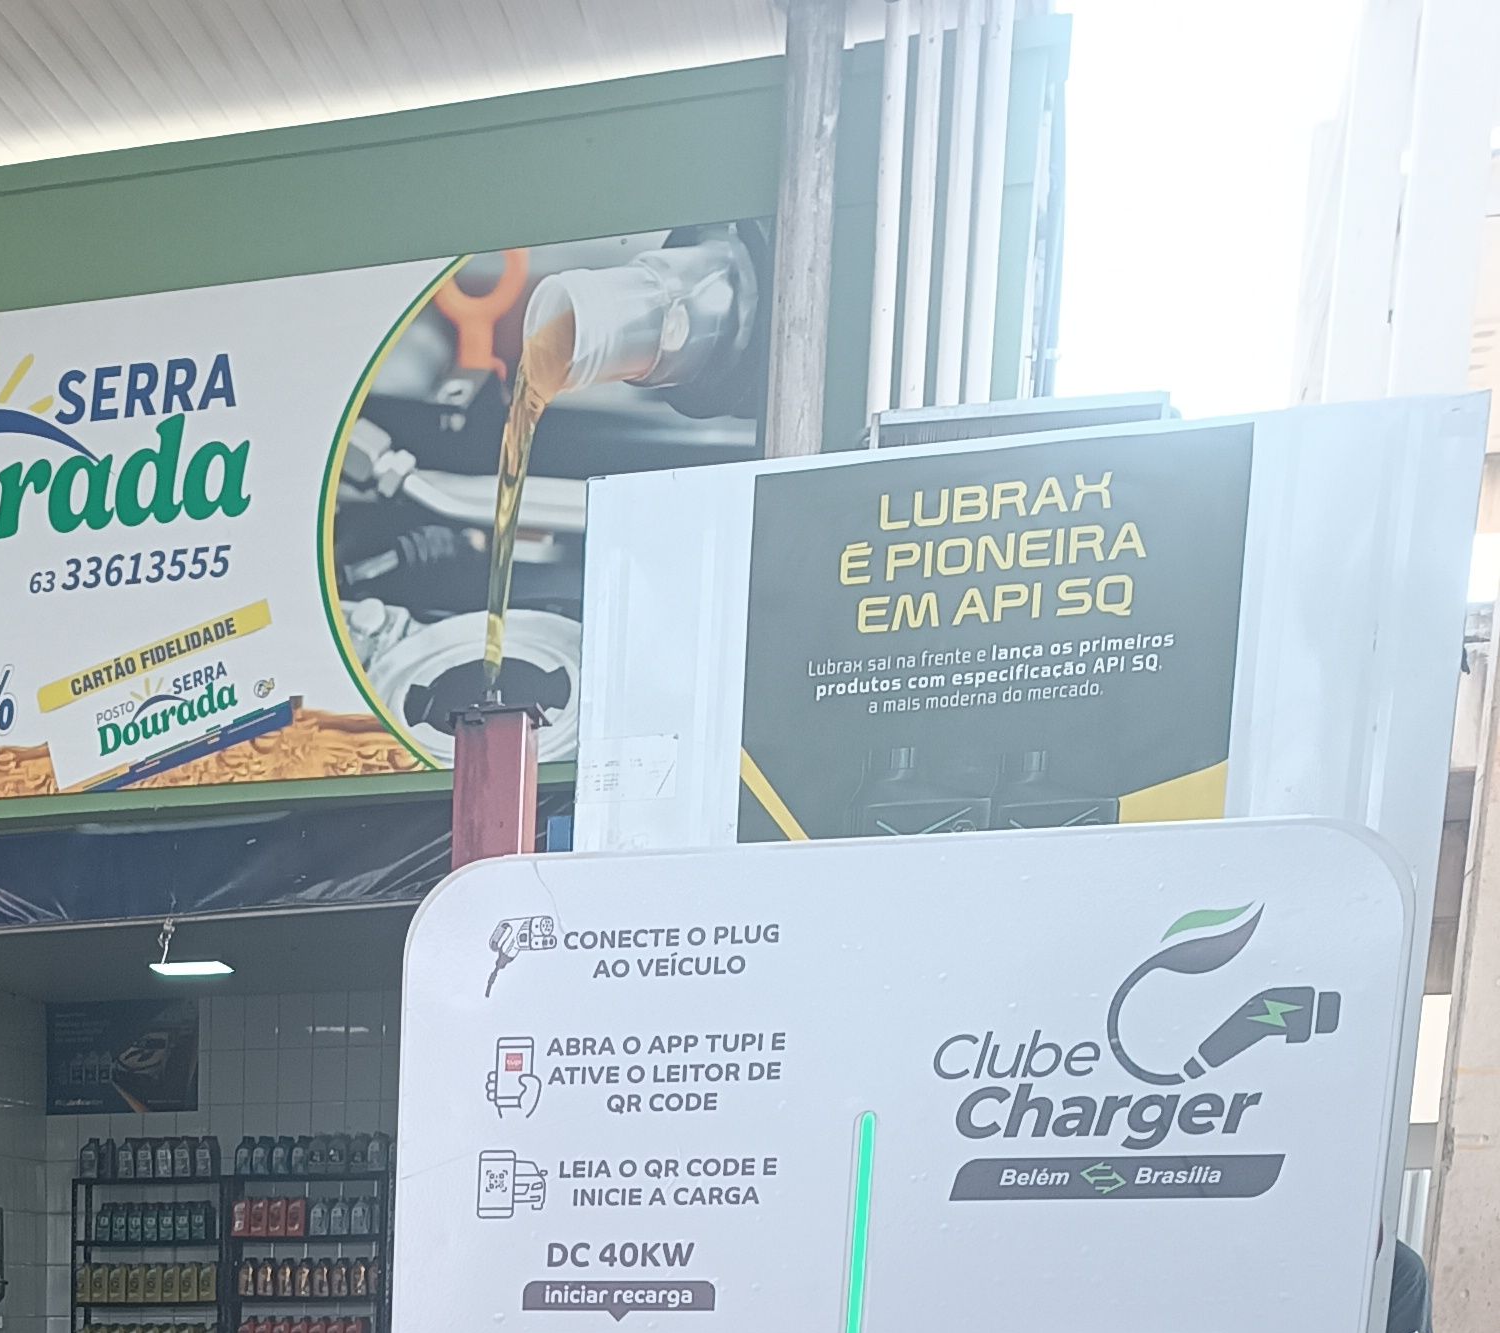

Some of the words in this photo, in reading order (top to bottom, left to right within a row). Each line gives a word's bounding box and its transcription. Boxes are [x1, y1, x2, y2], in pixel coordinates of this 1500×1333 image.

[56, 353, 237, 424] SERRA
[879, 470, 1113, 530] LUBRAX
[29, 571, 57, 595] 63
[61, 544, 232, 591] 33613555
[839, 542, 873, 586] É
[885, 522, 1147, 582] PIONEIRA
[857, 592, 940, 633] EM
[952, 582, 1042, 626] API
[1055, 574, 1134, 617] SQ
[71, 657, 136, 695] CARTÃO
[140, 617, 236, 669] FIDELIDADE
[808, 660, 863, 677] Lubrax
[896, 655, 916, 669] na
[921, 649, 970, 667] frente
[977, 649, 986, 663] e
[991, 643, 1043, 663] lança
[1050, 641, 1072, 656] os
[1079, 633, 1174, 656] primeiros
[172, 661, 227, 695] SERRA
[816, 675, 901, 700] produtos
[908, 674, 945, 689] com
[952, 661, 1086, 688] especificação
[1093, 656, 1124, 674] API
[96, 701, 134, 725] POSTO
[868, 700, 878, 714] a
[883, 695, 920, 712] mais
[926, 690, 996, 709] moderna
[1002, 685, 1022, 703] do
[98, 682, 238, 756] Dourada
[563, 928, 680, 950] CONECTE
[687, 926, 706, 947] O
[713, 924, 780, 945] PLUG
[592, 959, 630, 979] AO
[637, 952, 746, 977] VEÍCULO
[546, 1036, 615, 1057] ABRA
[622, 1036, 642, 1055] O
[647, 1035, 699, 1055] APP
[705, 1033, 764, 1053] TUPI
[771, 1032, 786, 1051] E
[933, 1029, 1101, 1080] Clube
[548, 1066, 620, 1085] ATIVE
[626, 1065, 645, 1083] O
[652, 1063, 741, 1083] LEITOR
[747, 1061, 781, 1081] DE
[607, 1094, 642, 1114] QR
[649, 1092, 718, 1112] CODE
[955, 1083, 1263, 1150] Charger
[559, 1160, 612, 1179] LEIA
[618, 1160, 637, 1178] O
[644, 1159, 679, 1179] QR
[686, 1158, 756, 1177] CODE
[763, 1158, 778, 1176] E
[999, 1167, 1070, 1187] Belém
[1134, 1164, 1222, 1185] Brasília
[572, 1188, 642, 1206] INICIE
[648, 1187, 666, 1206] A
[673, 1186, 760, 1206] CARGA
[547, 1242, 591, 1268] DC
[598, 1242, 695, 1268] 40KW
[544, 1285, 608, 1305] iniciar
[613, 1288, 693, 1308] recarga
